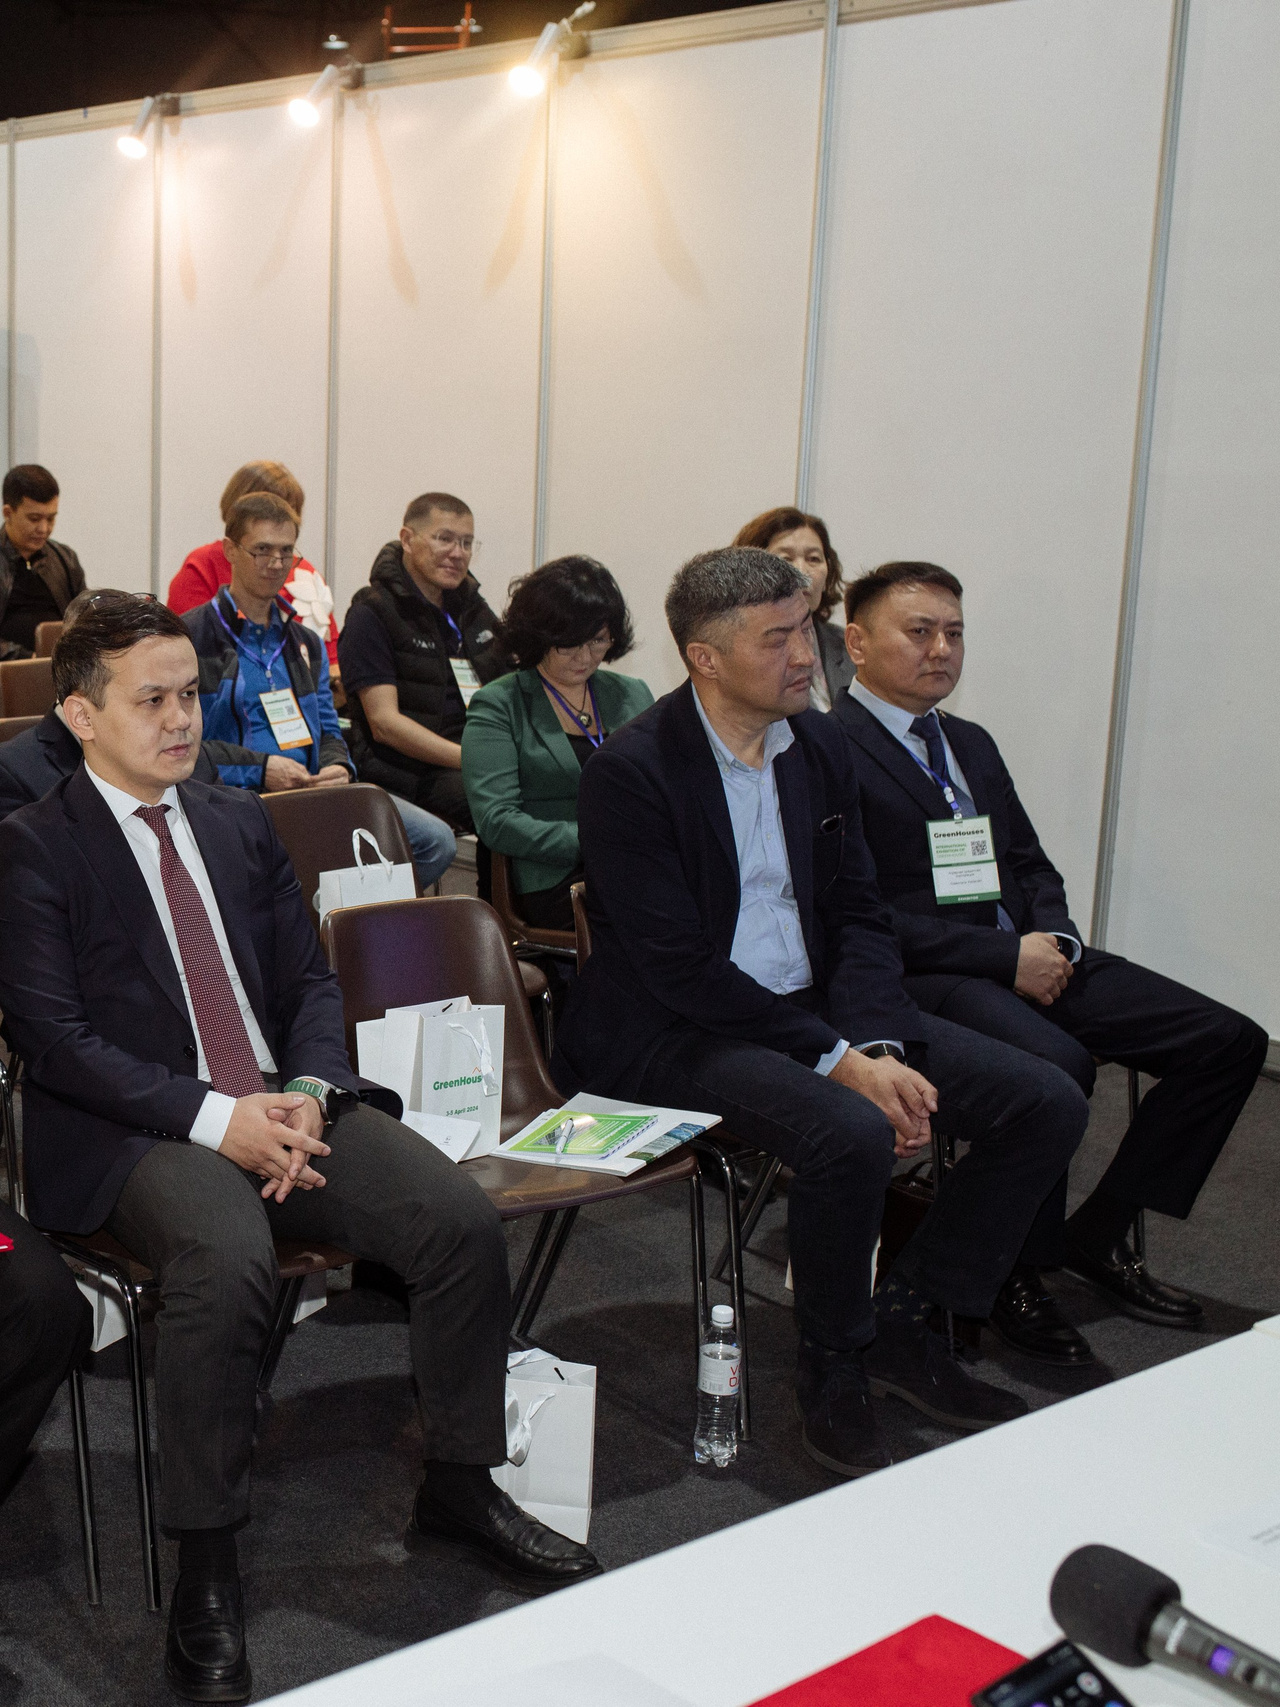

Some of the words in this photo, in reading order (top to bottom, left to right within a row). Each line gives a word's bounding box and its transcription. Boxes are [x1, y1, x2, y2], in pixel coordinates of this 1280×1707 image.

[933, 829, 984, 838] GreenHouses
[433, 1075, 482, 1091] GreenHous
[454, 1107, 466, 1116] April
[466, 1105, 479, 1113] 2024
